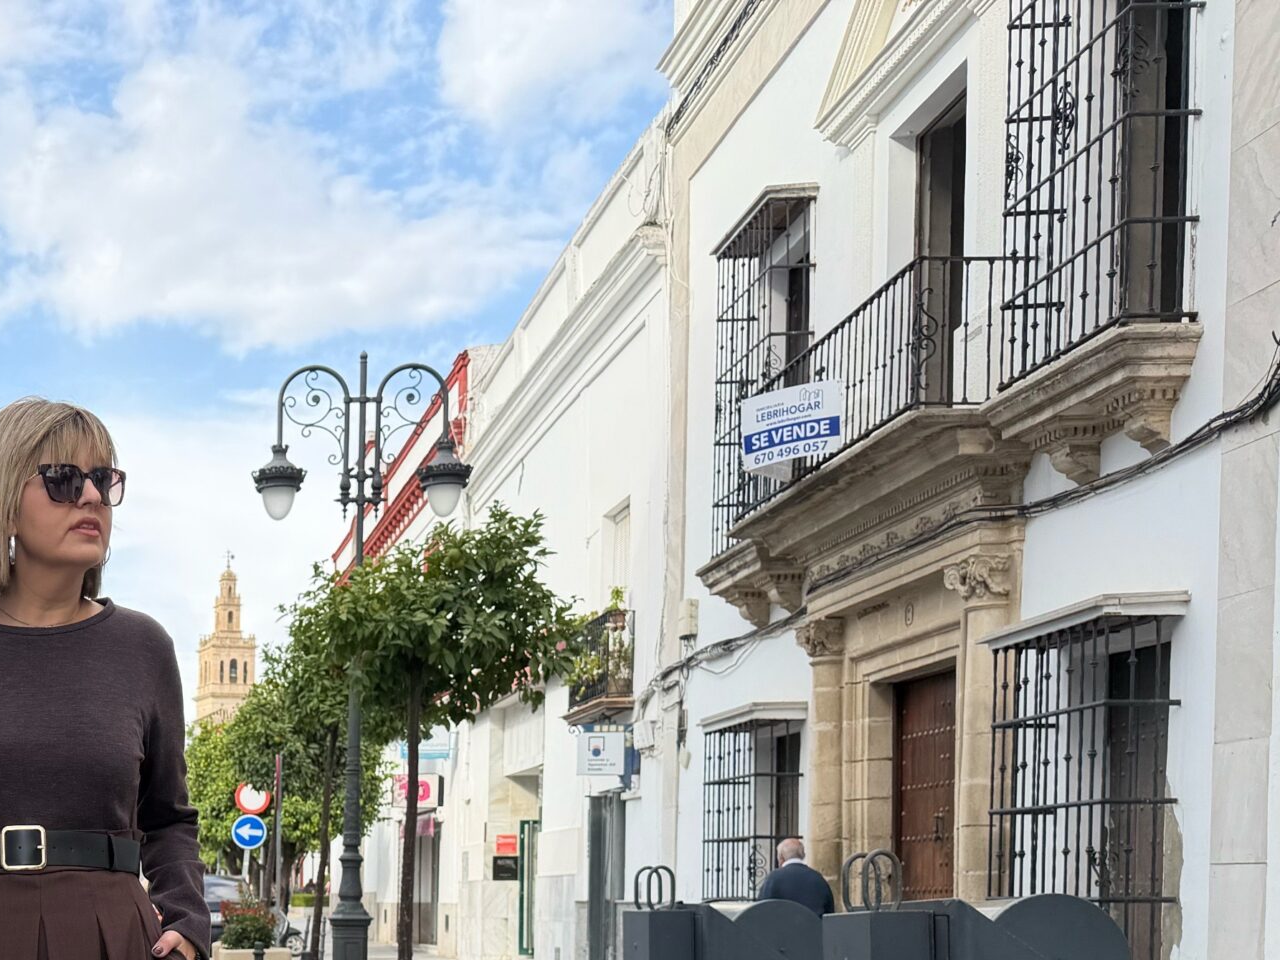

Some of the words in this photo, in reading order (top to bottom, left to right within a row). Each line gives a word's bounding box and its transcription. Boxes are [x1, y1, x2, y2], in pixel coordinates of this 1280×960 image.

[756, 401, 821, 423] LEBRIHOGAR
[751, 432, 770, 450] SE
[771, 420, 831, 444] VENDE
[754, 451, 774, 465] 670
[777, 445, 800, 459] 496
[803, 440, 829, 453] 057
